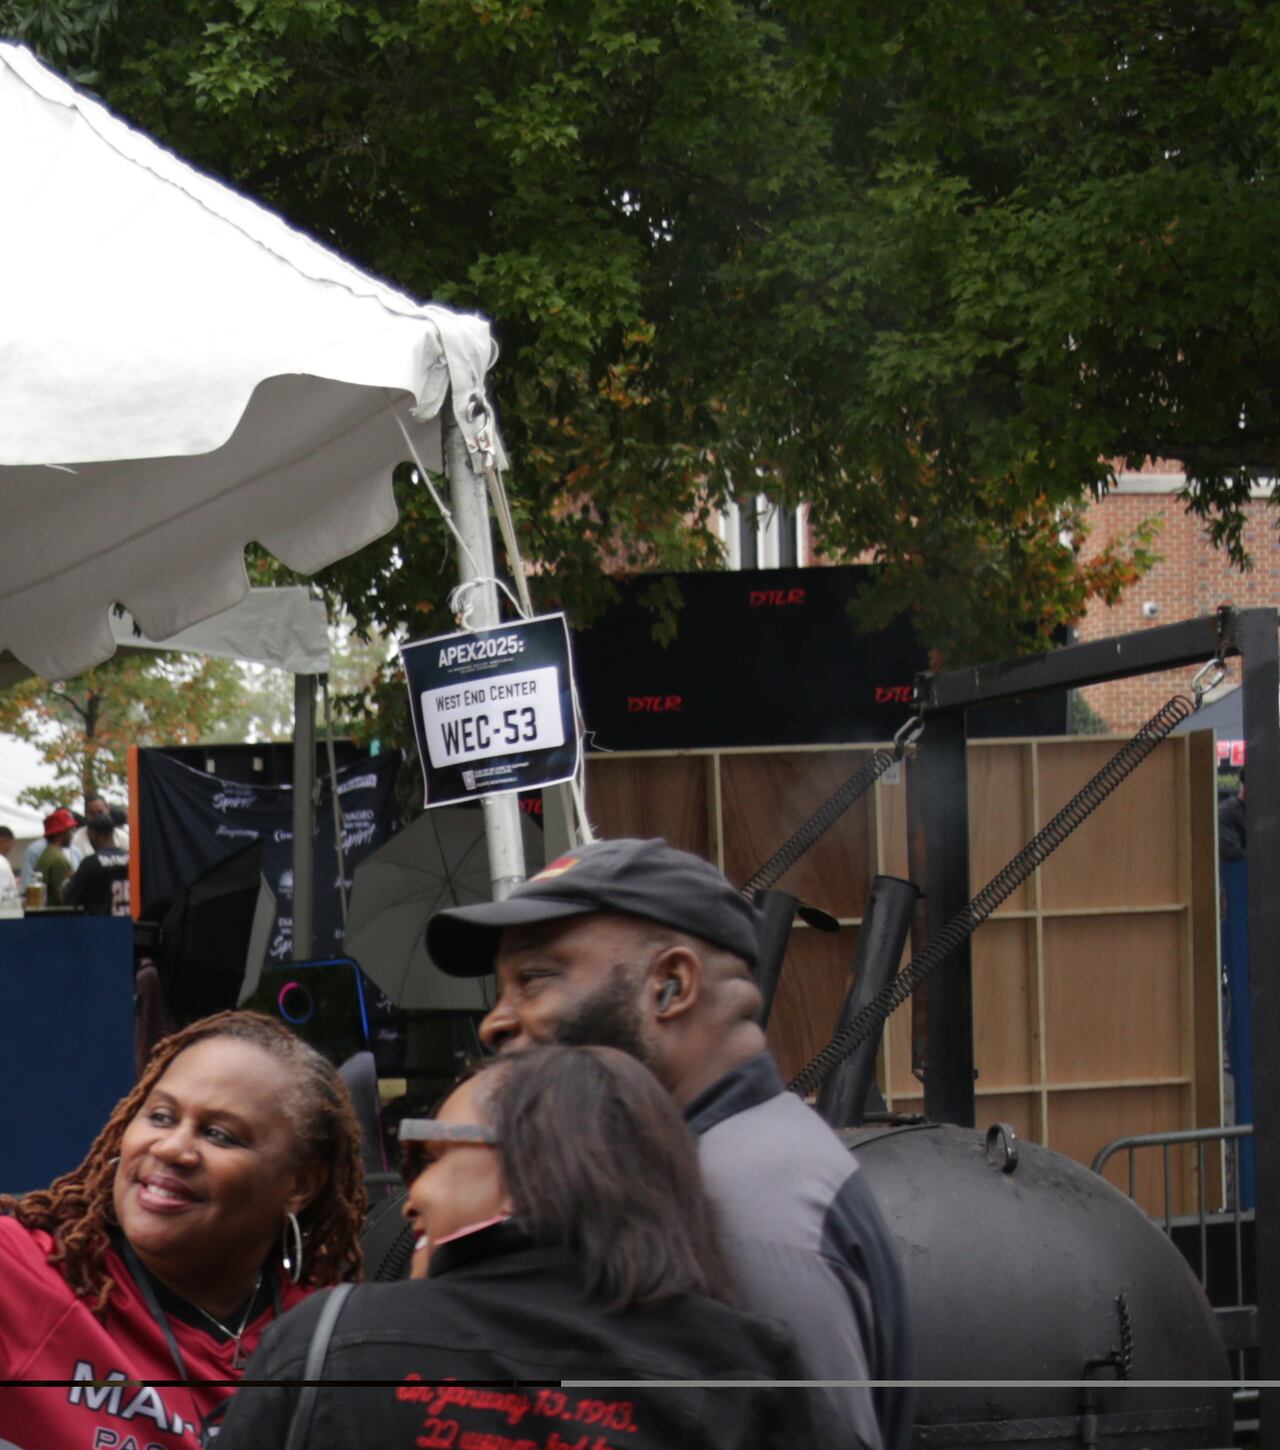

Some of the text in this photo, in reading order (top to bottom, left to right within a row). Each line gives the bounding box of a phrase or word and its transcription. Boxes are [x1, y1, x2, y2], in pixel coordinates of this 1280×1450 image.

[748, 588, 806, 608] DTLR
[438, 633, 526, 669] APEX2025:
[626, 694, 684, 713] DTLR
[874, 685, 913, 704] DTL
[440, 706, 539, 757] WEC-53
